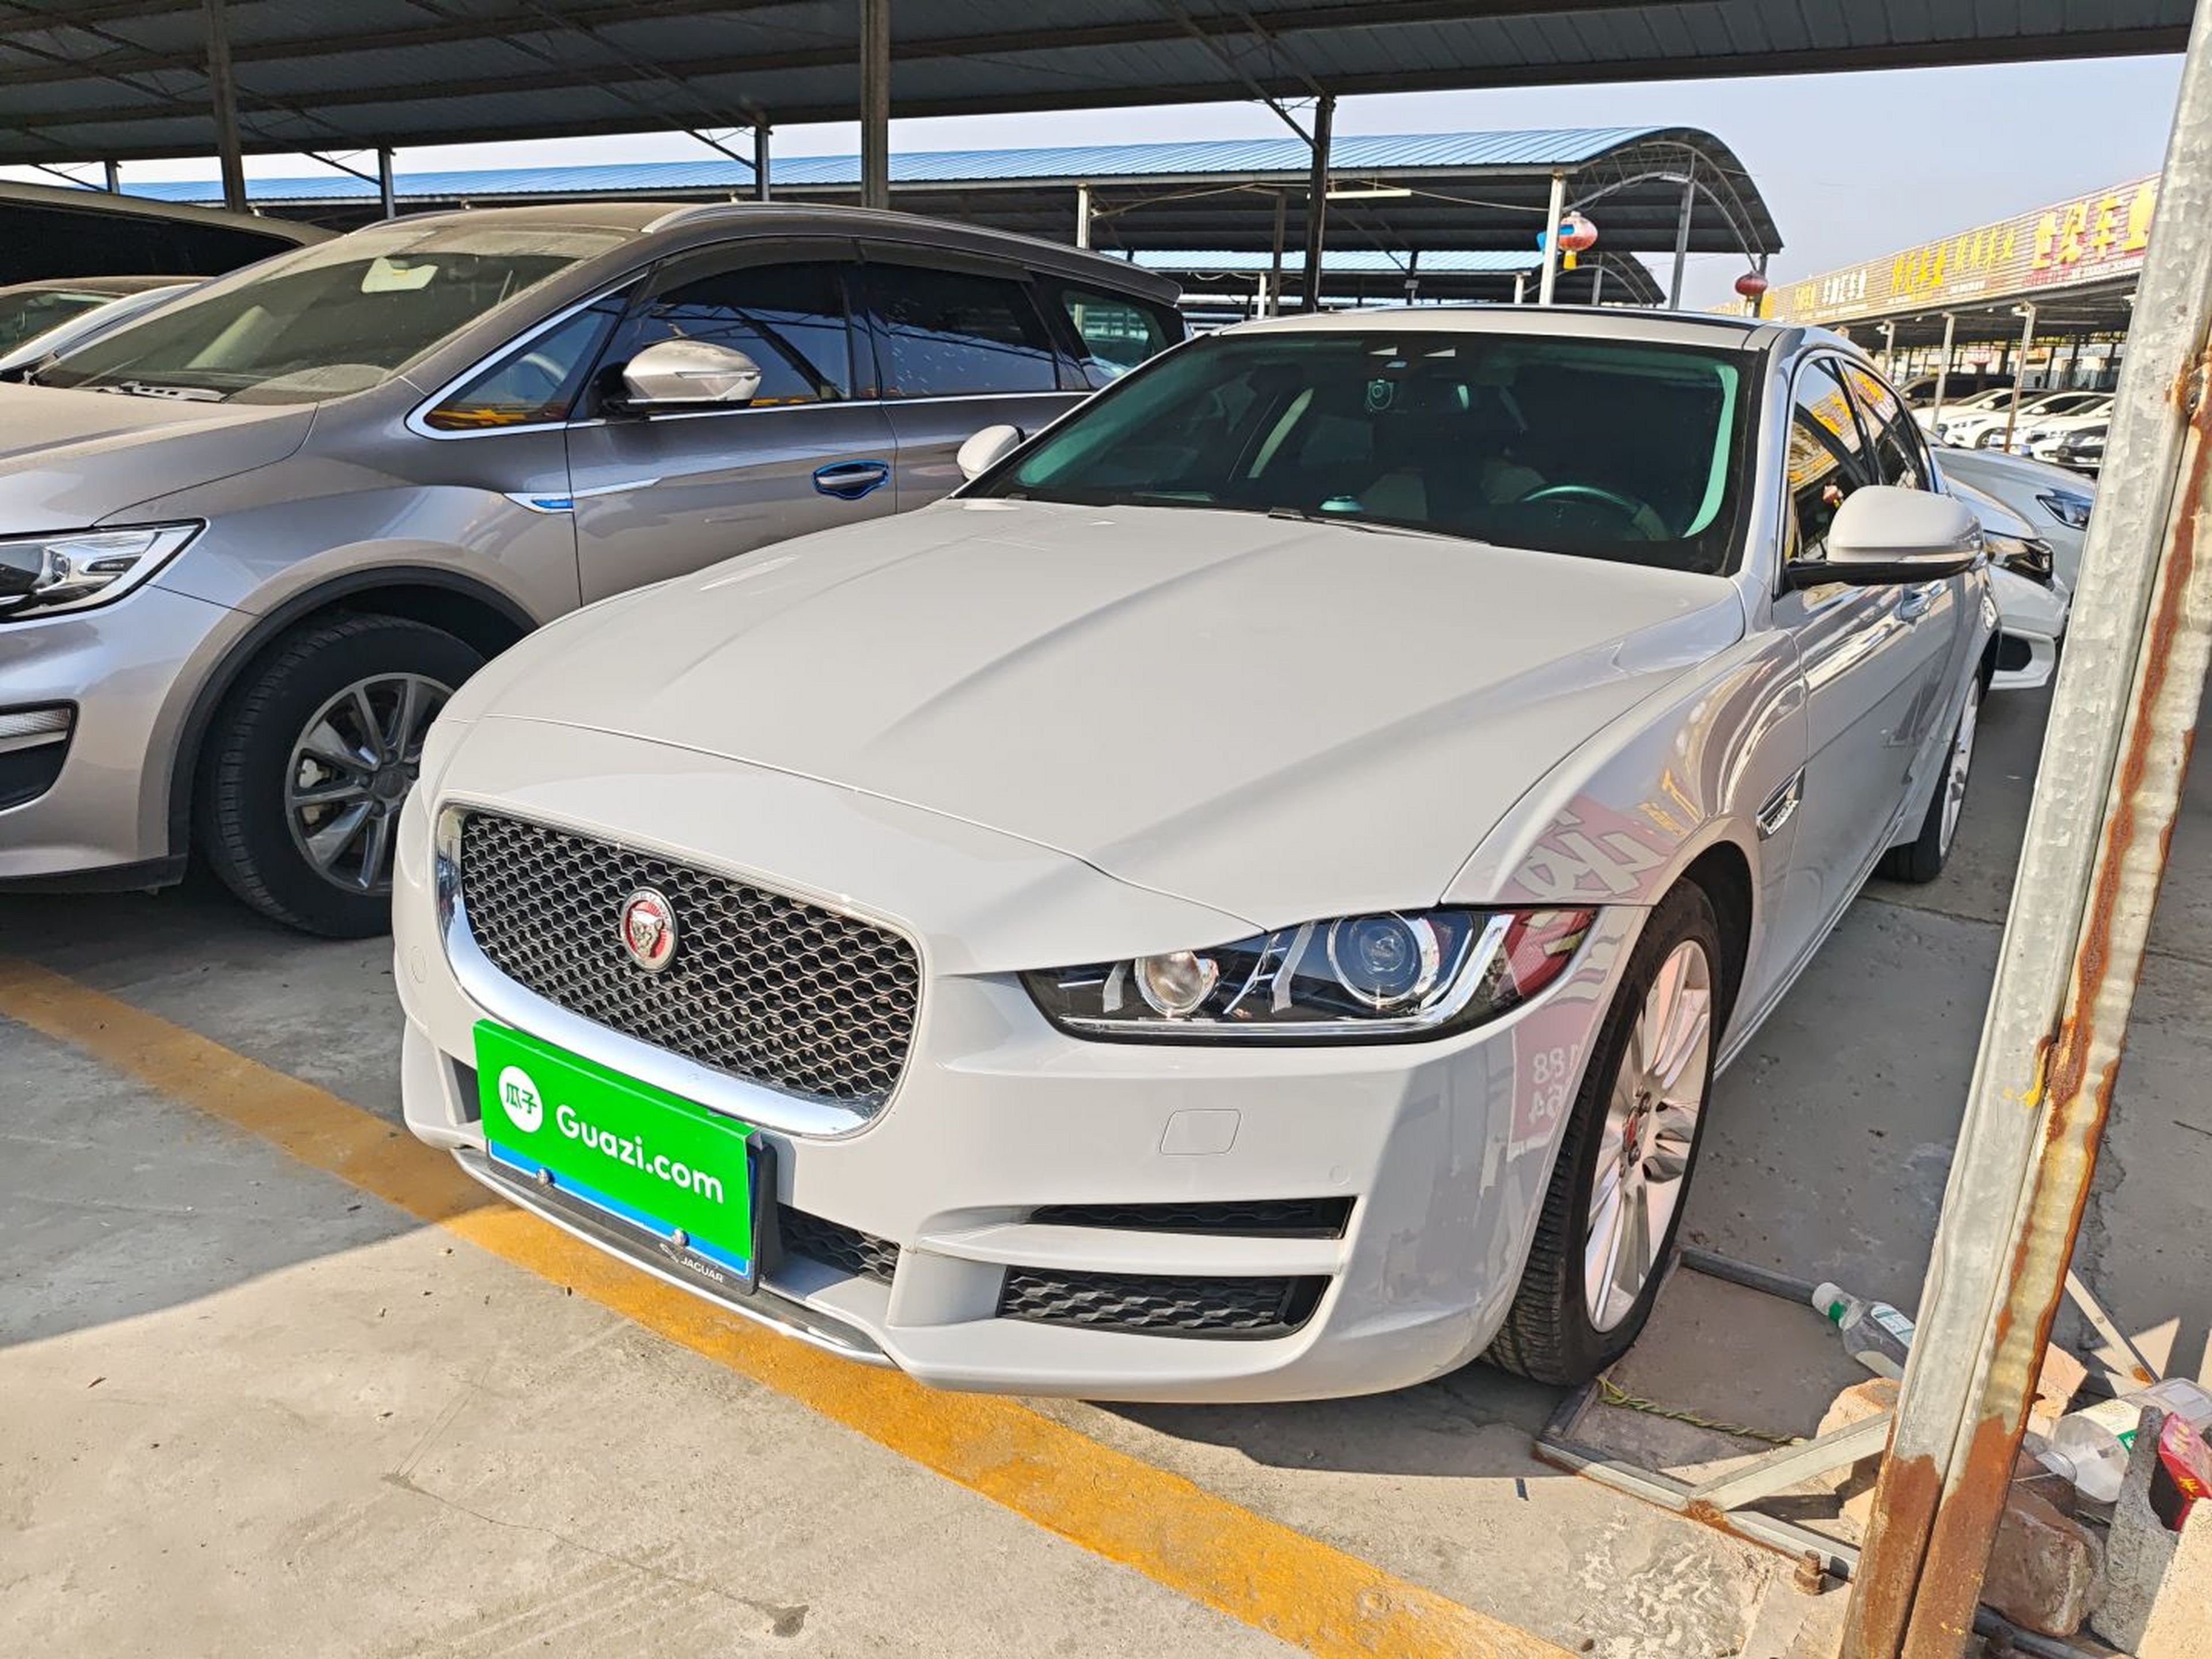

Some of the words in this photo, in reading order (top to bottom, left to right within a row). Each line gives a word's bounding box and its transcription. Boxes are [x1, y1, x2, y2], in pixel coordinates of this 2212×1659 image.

[506, 1082, 537, 1114] 瓜子
[556, 1104, 724, 1205] Guazi.com
[680, 1256, 724, 1283] JAGUAR
